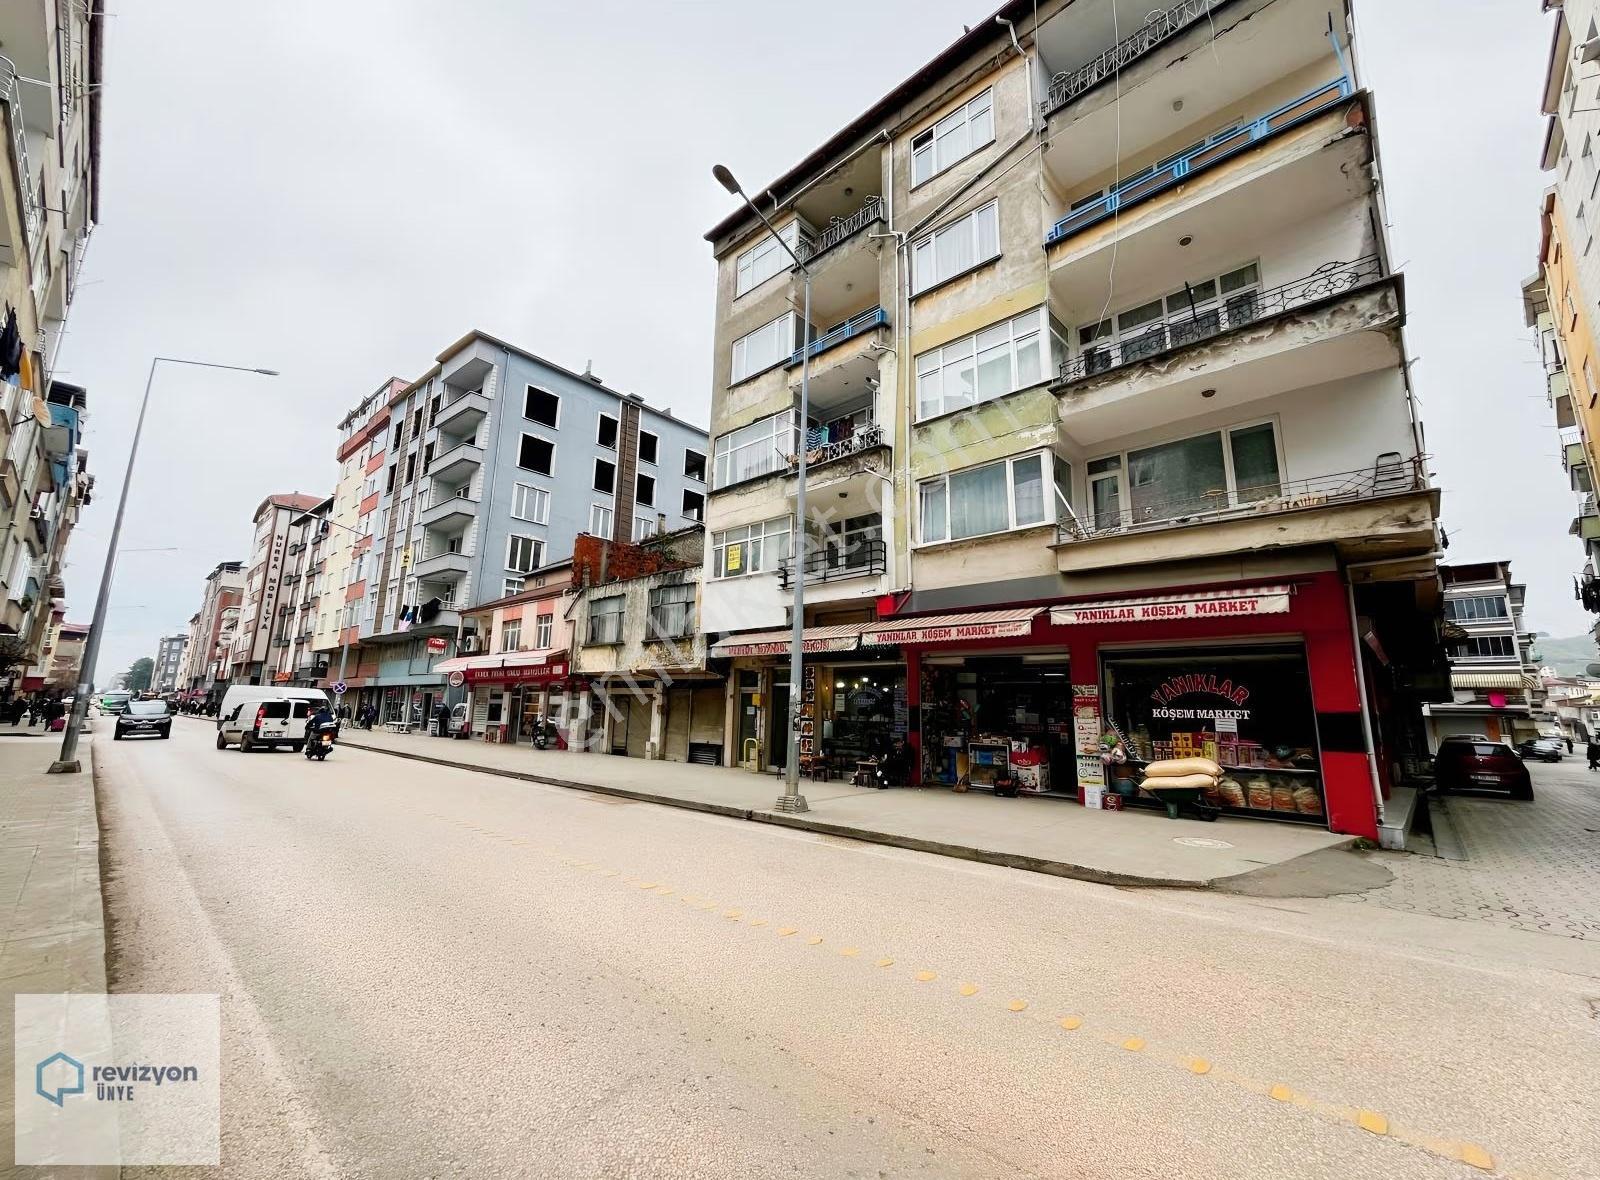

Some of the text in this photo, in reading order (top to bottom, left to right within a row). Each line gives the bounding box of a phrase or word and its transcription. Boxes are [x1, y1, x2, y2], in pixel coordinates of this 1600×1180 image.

[1074, 607, 1134, 622] YANIKLAR
[1194, 600, 1259, 614] MARKET
[876, 631, 917, 643] YANIKLAR
[956, 625, 998, 637] MARKET
[1150, 673, 1250, 706] YANIKLAR
[1152, 706, 1251, 721] KÖŞEM MARKET
